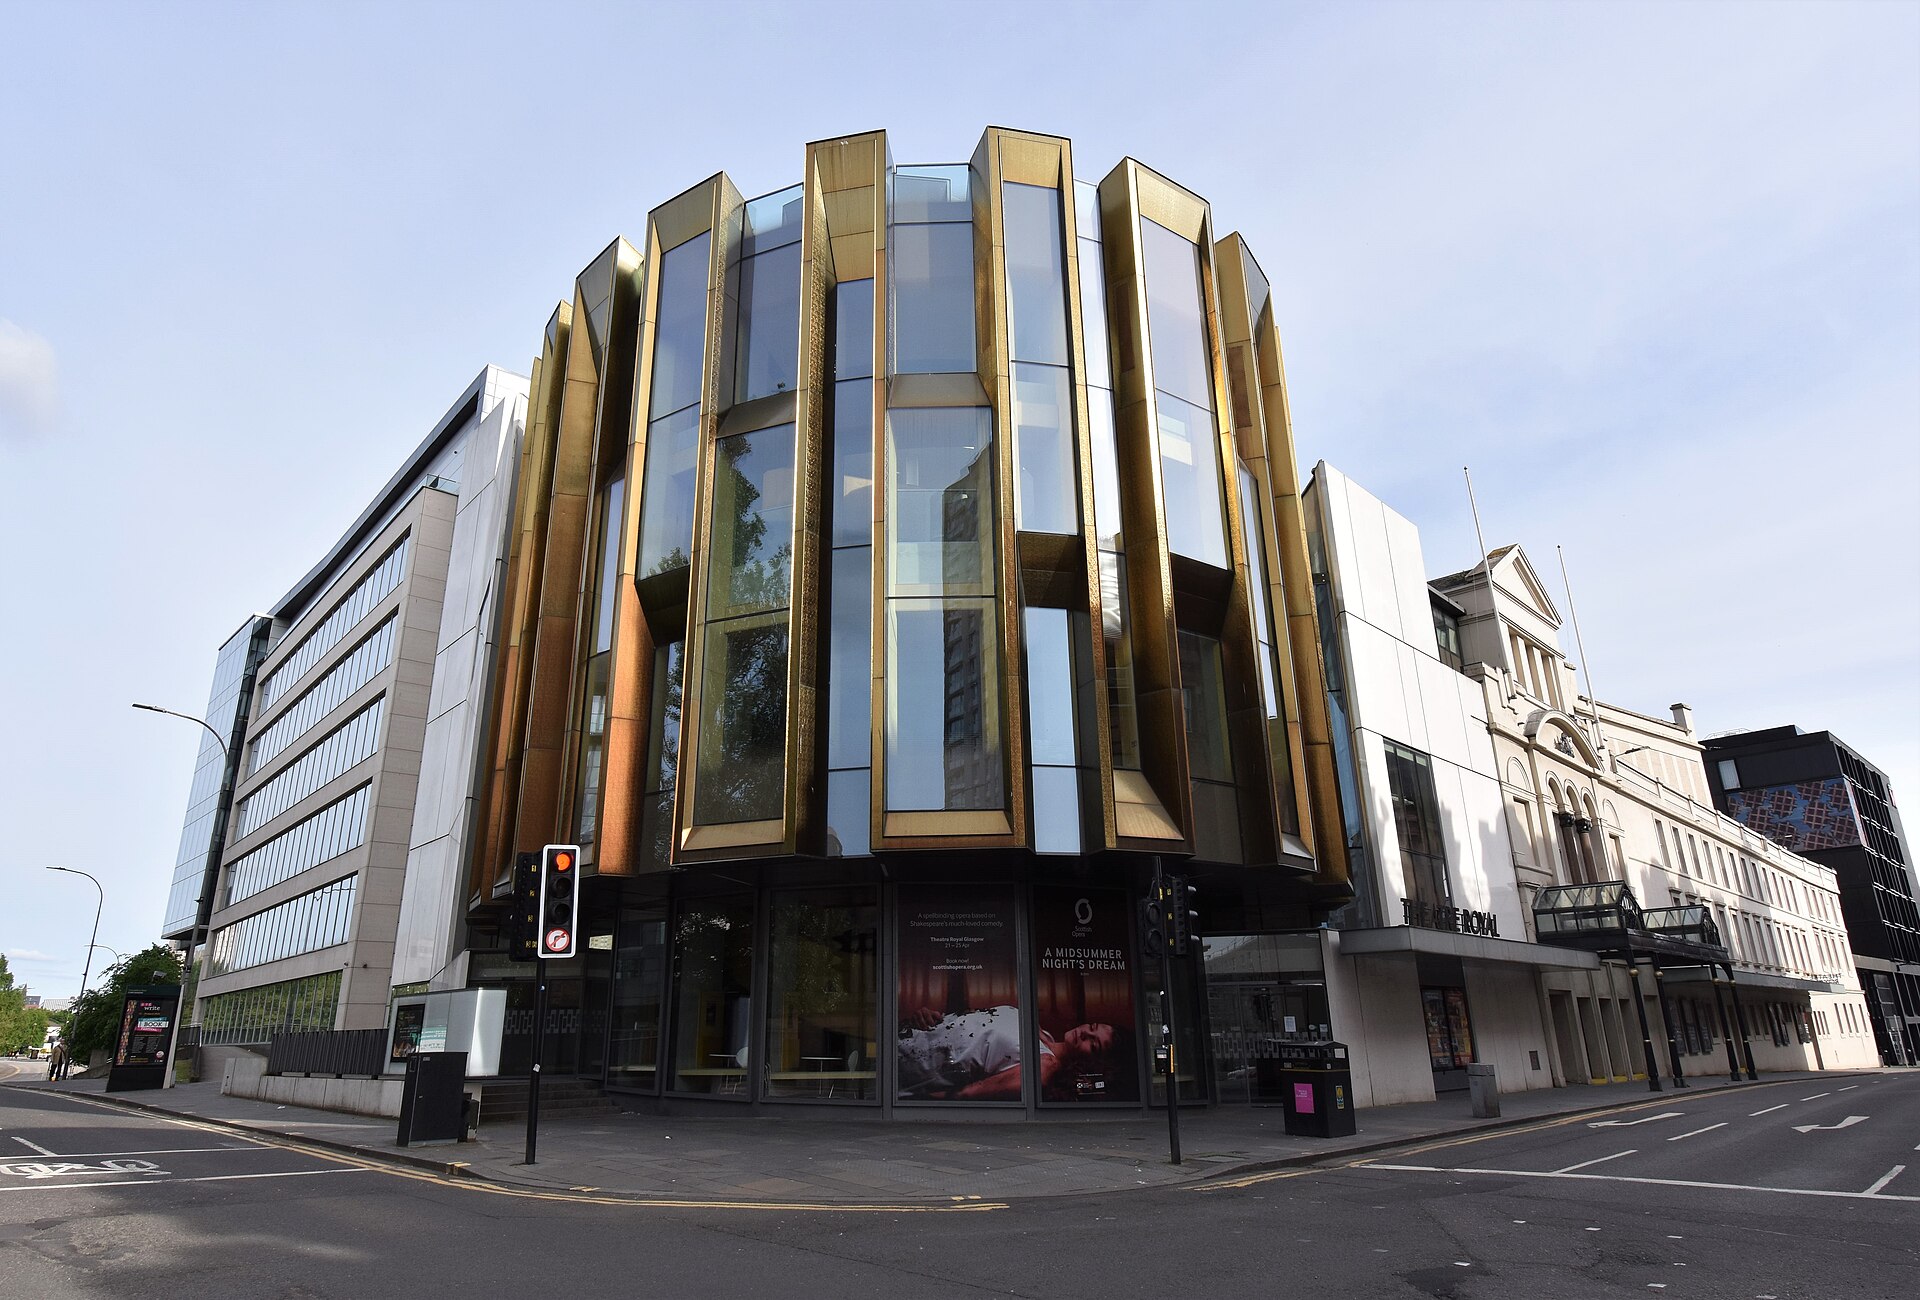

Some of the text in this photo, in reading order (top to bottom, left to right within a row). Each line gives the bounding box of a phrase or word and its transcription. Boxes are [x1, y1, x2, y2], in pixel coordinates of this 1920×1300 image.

[1462, 909, 1500, 937] ROYAL
[1044, 947, 1122, 959] A MIDSUMMER
[1042, 959, 1125, 970] NIGHT'S DREAM
